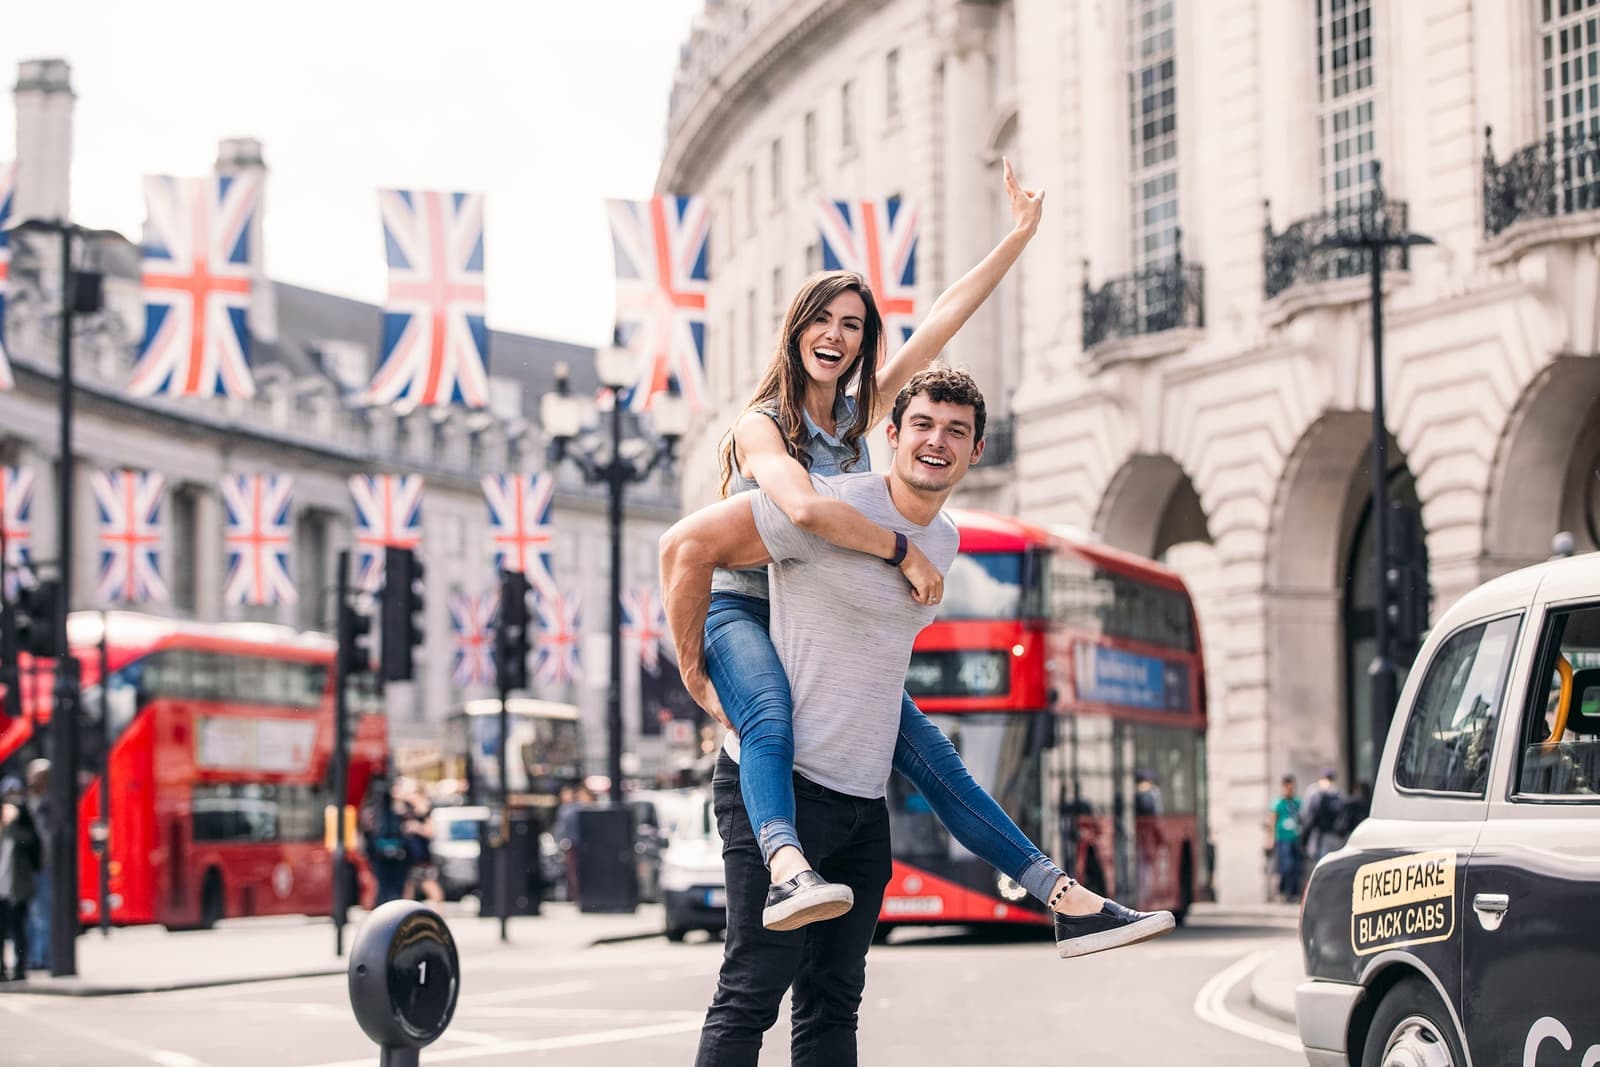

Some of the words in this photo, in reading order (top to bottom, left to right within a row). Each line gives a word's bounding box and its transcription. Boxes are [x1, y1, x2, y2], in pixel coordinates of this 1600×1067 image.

[1362, 868, 1402, 900] FIXED
[1406, 858, 1447, 891] FARE
[1359, 911, 1402, 944] BLACK
[1405, 903, 1445, 934] CABS
[418, 961, 426, 984] 1
